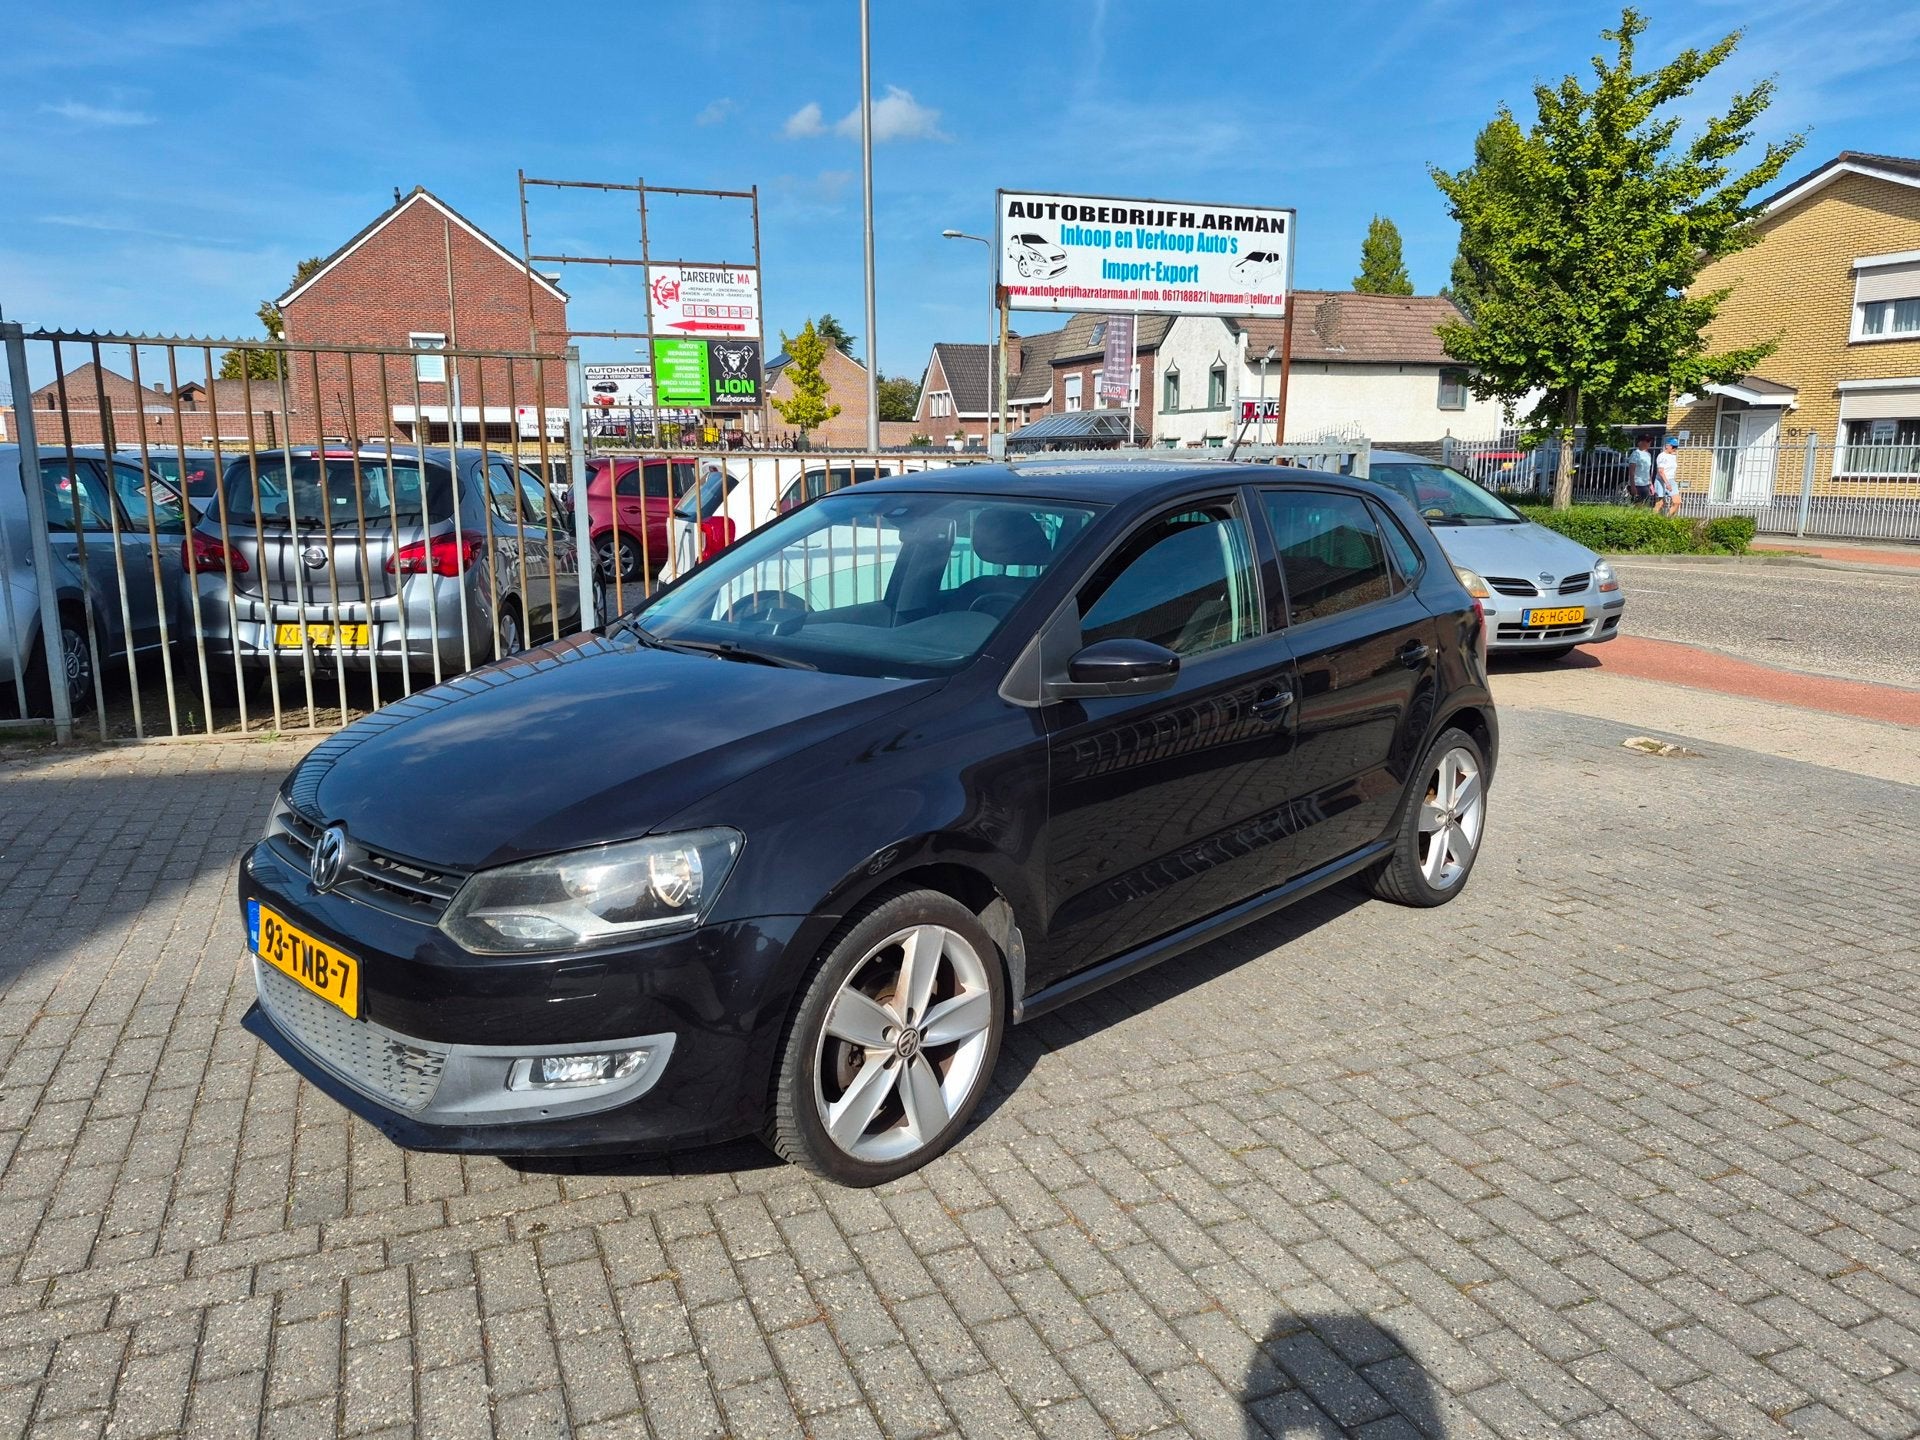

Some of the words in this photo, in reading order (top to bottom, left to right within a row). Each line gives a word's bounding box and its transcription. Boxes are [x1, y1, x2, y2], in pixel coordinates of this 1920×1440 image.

[1060, 224, 1110, 249] Inkoop
[1115, 232, 1132, 248] en
[1136, 228, 1194, 254] Verkoop
[1197, 232, 1238, 254] Auto's
[680, 270, 734, 284] CARSERVICE
[737, 274, 750, 284] MA
[1102, 259, 1199, 284] Import-Export
[716, 380, 755, 394] LION
[1787, 428, 1802, 438] 101
[1532, 610, 1581, 623] 86-HG-GD
[265, 918, 350, 999] 93-TNB-7
